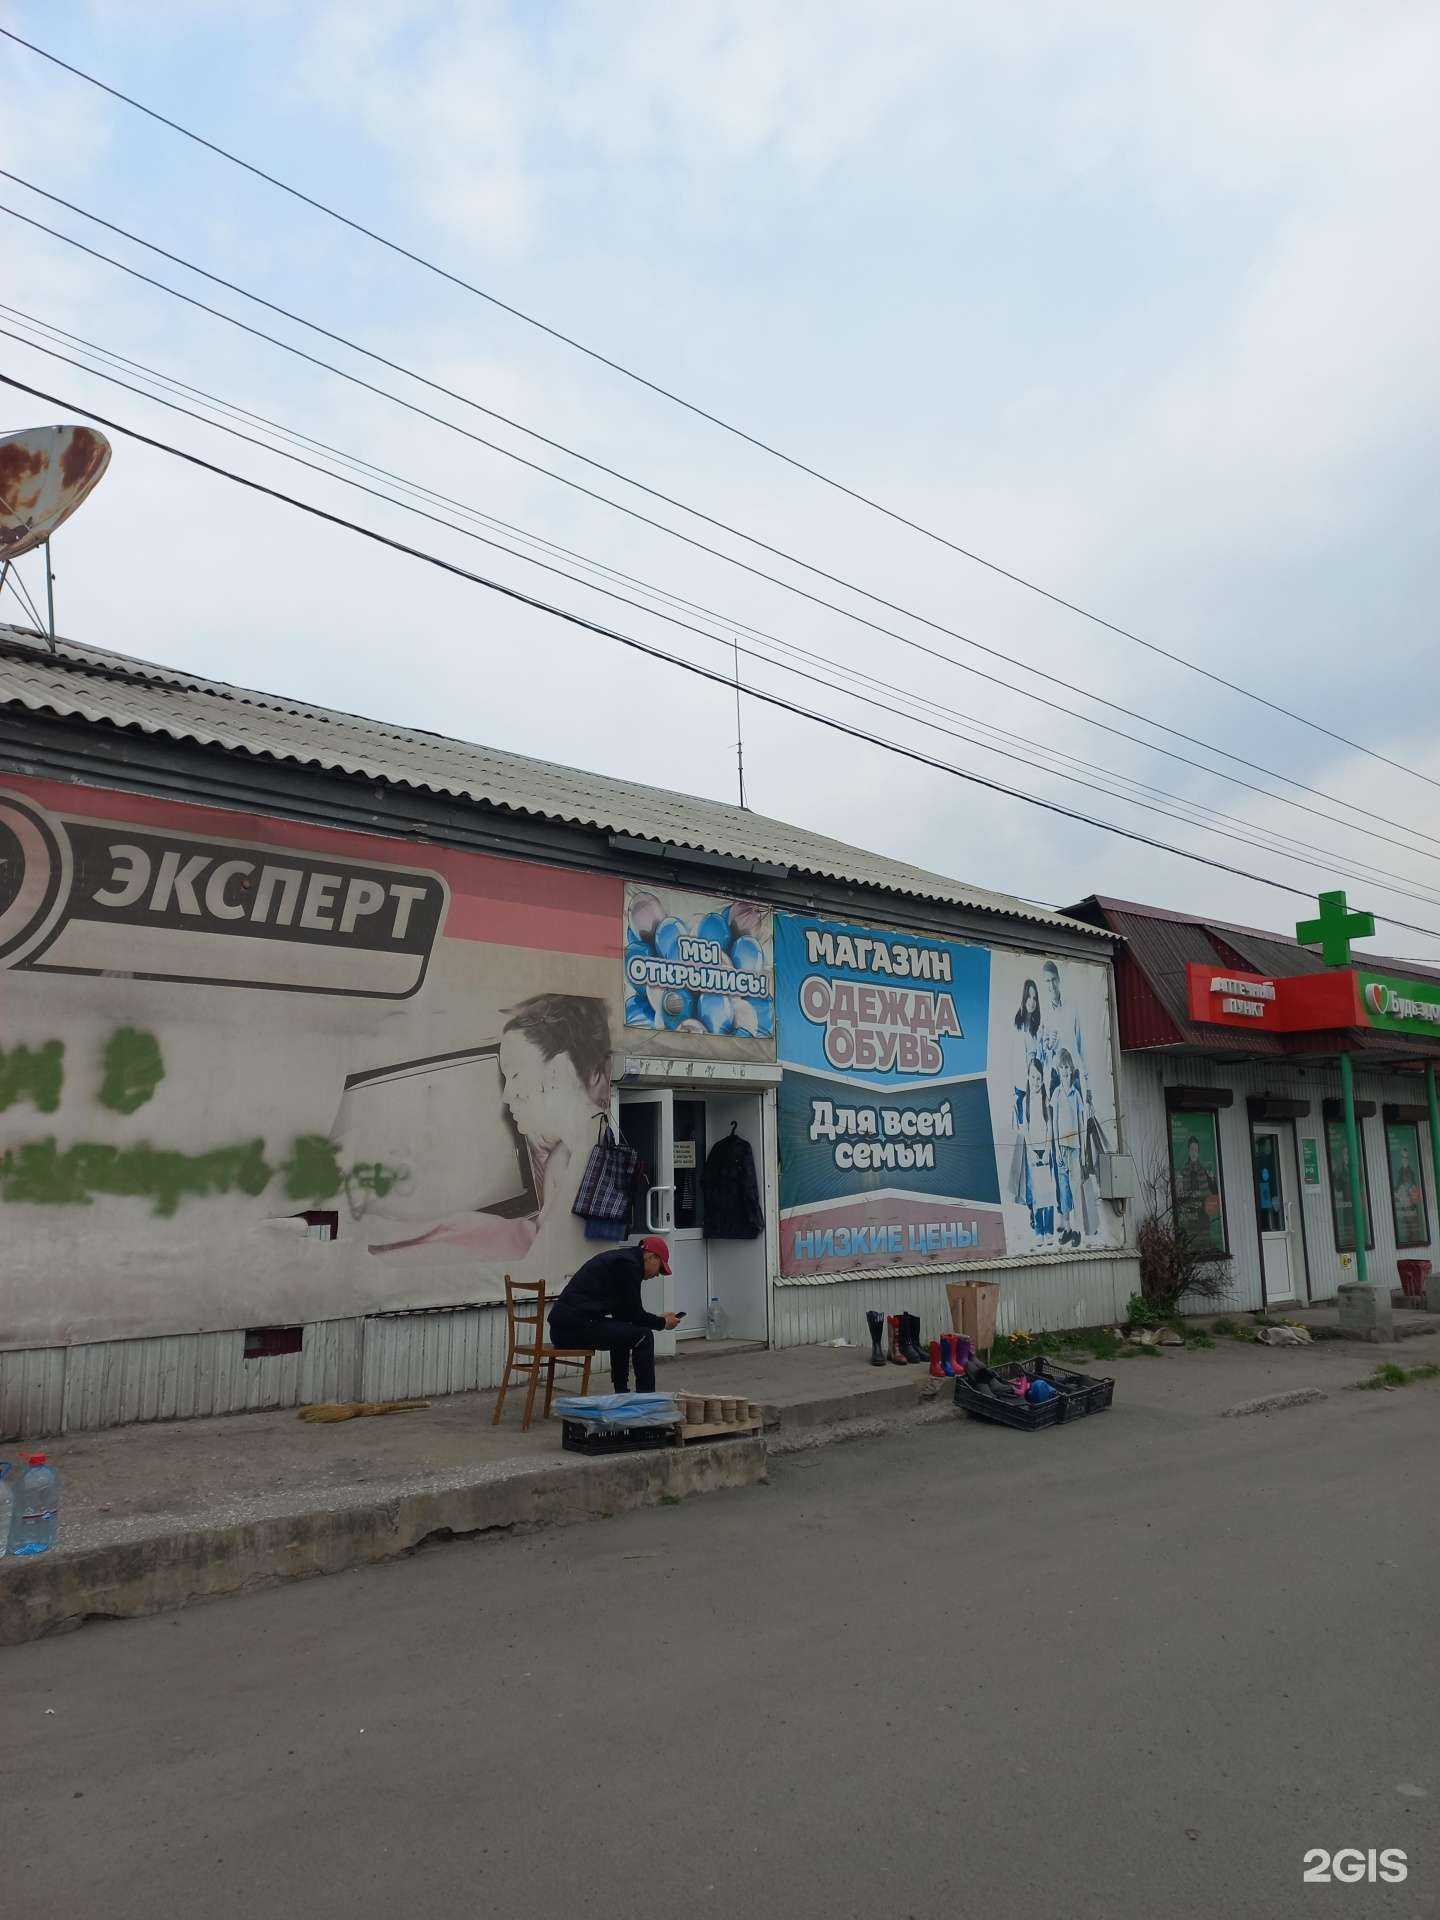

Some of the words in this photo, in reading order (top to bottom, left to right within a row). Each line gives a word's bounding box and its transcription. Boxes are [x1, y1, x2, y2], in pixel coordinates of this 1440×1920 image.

[92, 844, 428, 940] ЭКСПЕРТ
[679, 938, 722, 965] МЫ
[805, 930, 953, 982] МАГАЗИН
[629, 958, 768, 995] ОТКРЫЛИСЬ!
[802, 978, 961, 1036] ОДЕЖДА
[827, 1025, 942, 1071] ОБУВЬ
[810, 1101, 876, 1140] Для
[881, 1102, 953, 1137] всей
[835, 1142, 934, 1168] семьи
[794, 1225, 903, 1260] НИЗКИЕ
[908, 1221, 978, 1257] ЦЕНЫ
